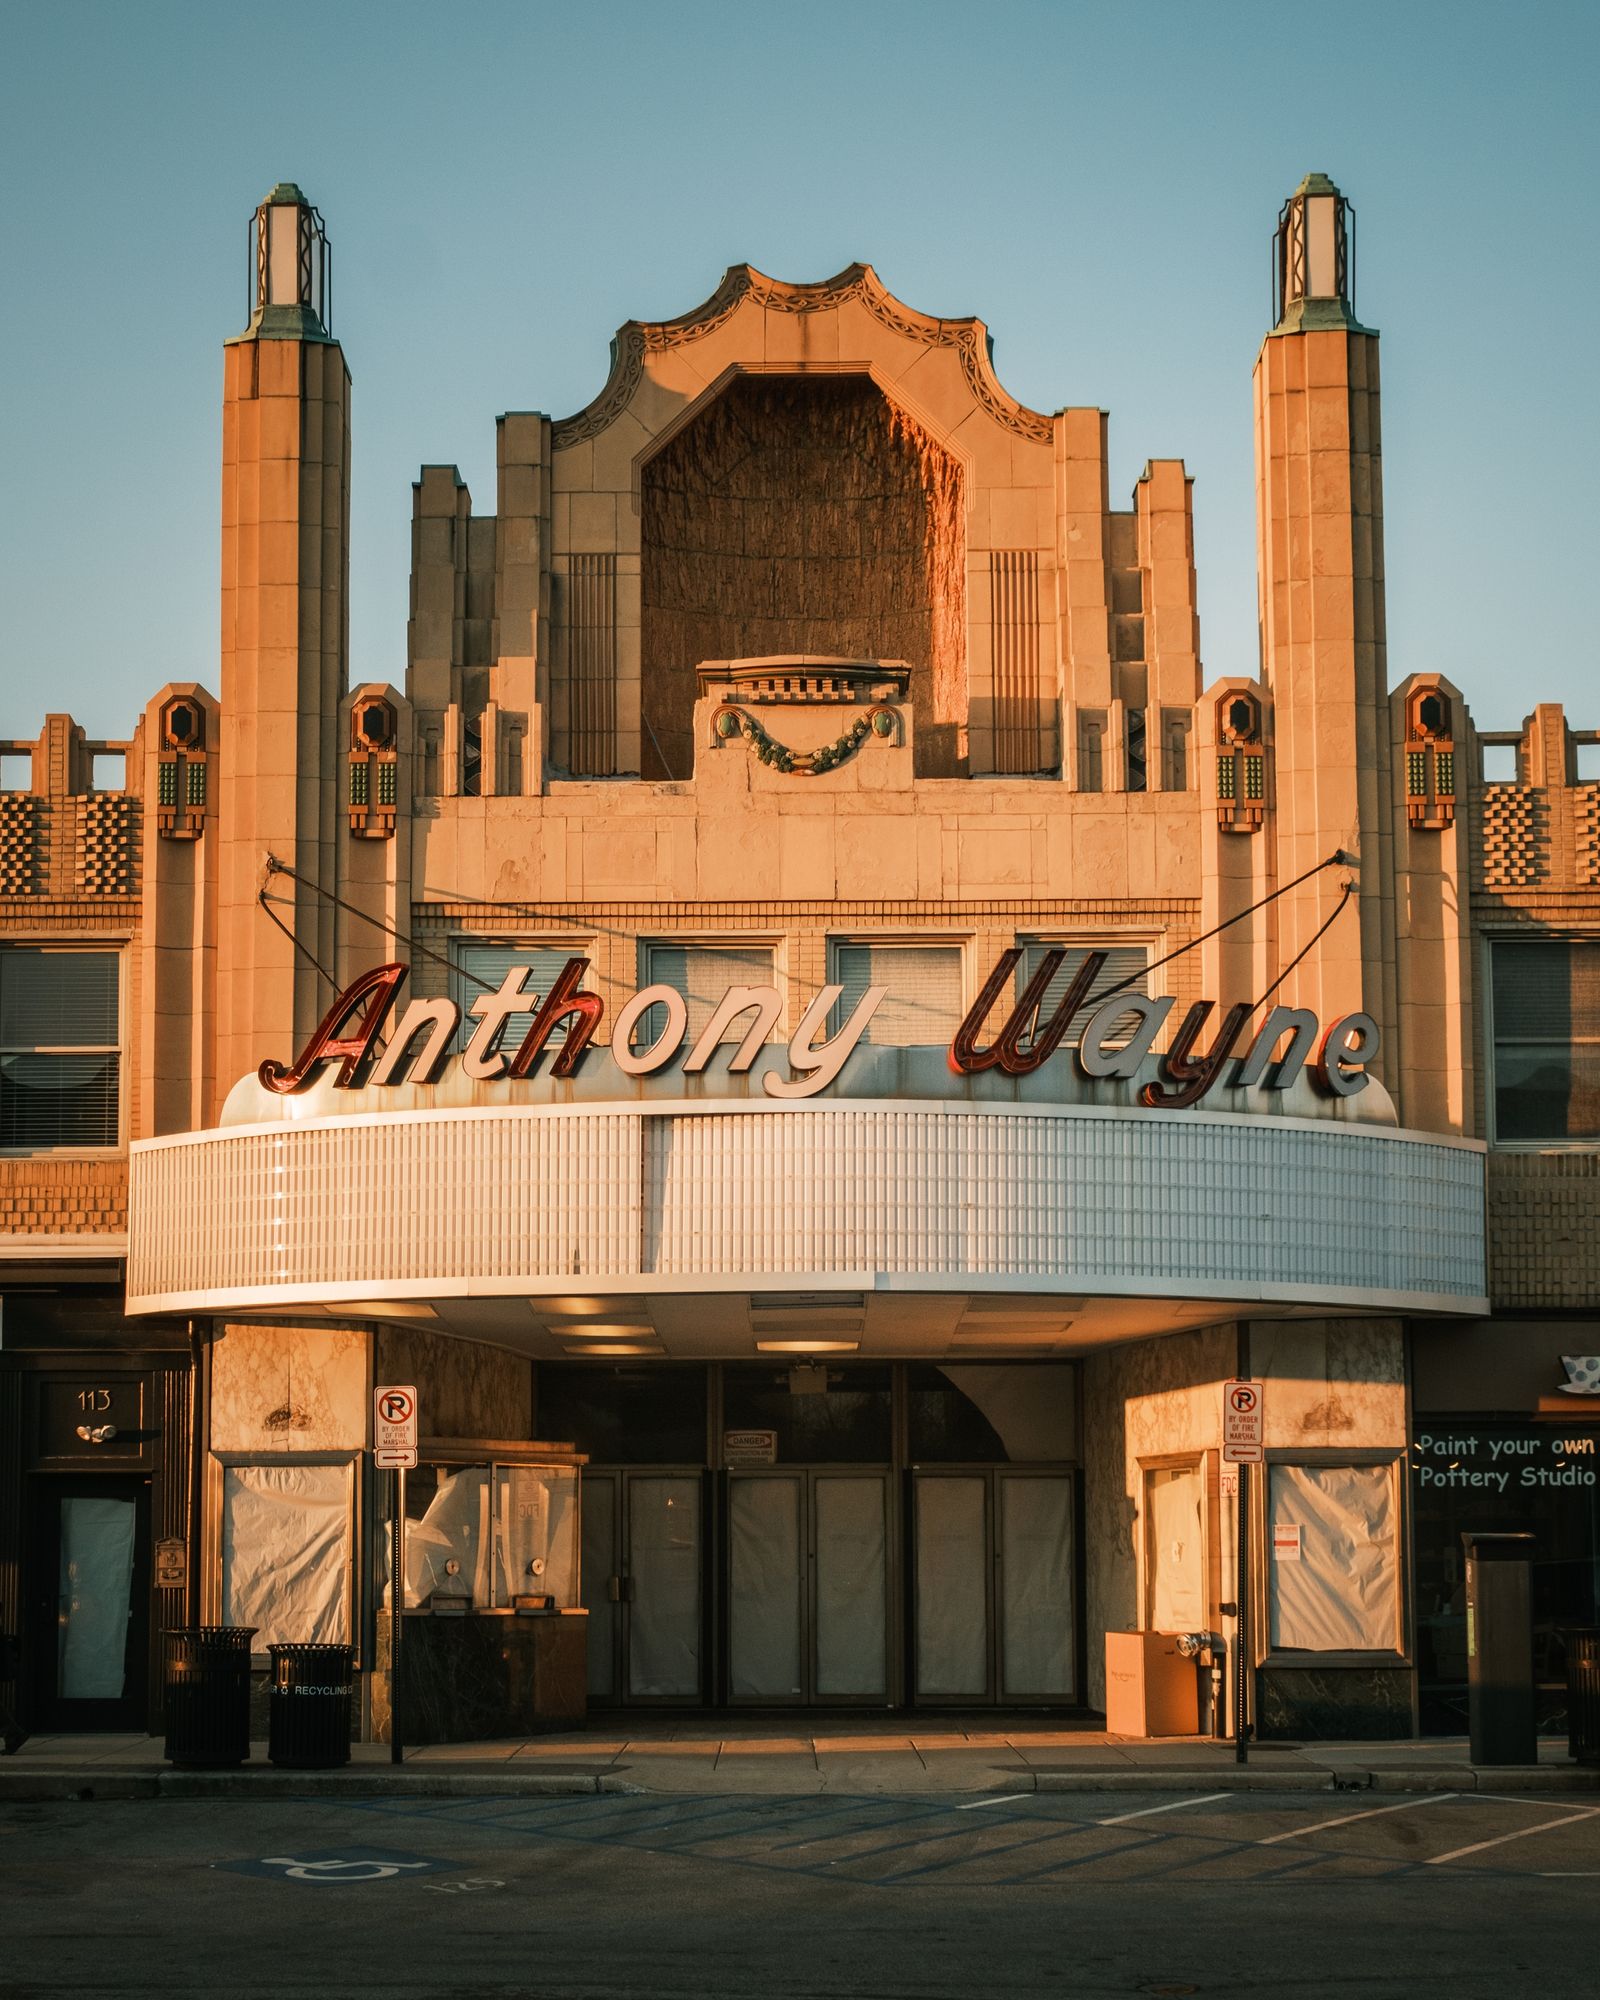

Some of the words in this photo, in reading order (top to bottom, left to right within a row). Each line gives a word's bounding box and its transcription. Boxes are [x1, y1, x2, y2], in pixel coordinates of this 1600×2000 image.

[258, 957, 889, 1099] Anthony
[947, 948, 1382, 1108] Wayne
[78, 1389, 111, 1411] 113
[1229, 1415, 1237, 1423] BY
[1238, 1415, 1258, 1423] ORDER
[1232, 1424, 1239, 1432] OF
[1241, 1424, 1255, 1432] FIRE
[733, 1436, 766, 1445] DANGER
[1229, 1432, 1257, 1440] MARSHAL
[1420, 1435, 1479, 1455] Paint
[1489, 1440, 1541, 1461] your
[1551, 1438, 1595, 1455] own
[1221, 1476, 1237, 1493] FDC
[1420, 1466, 1509, 1493] Pottery
[1519, 1465, 1596, 1486] Studio
[294, 1685, 347, 1696] RECYCLING
